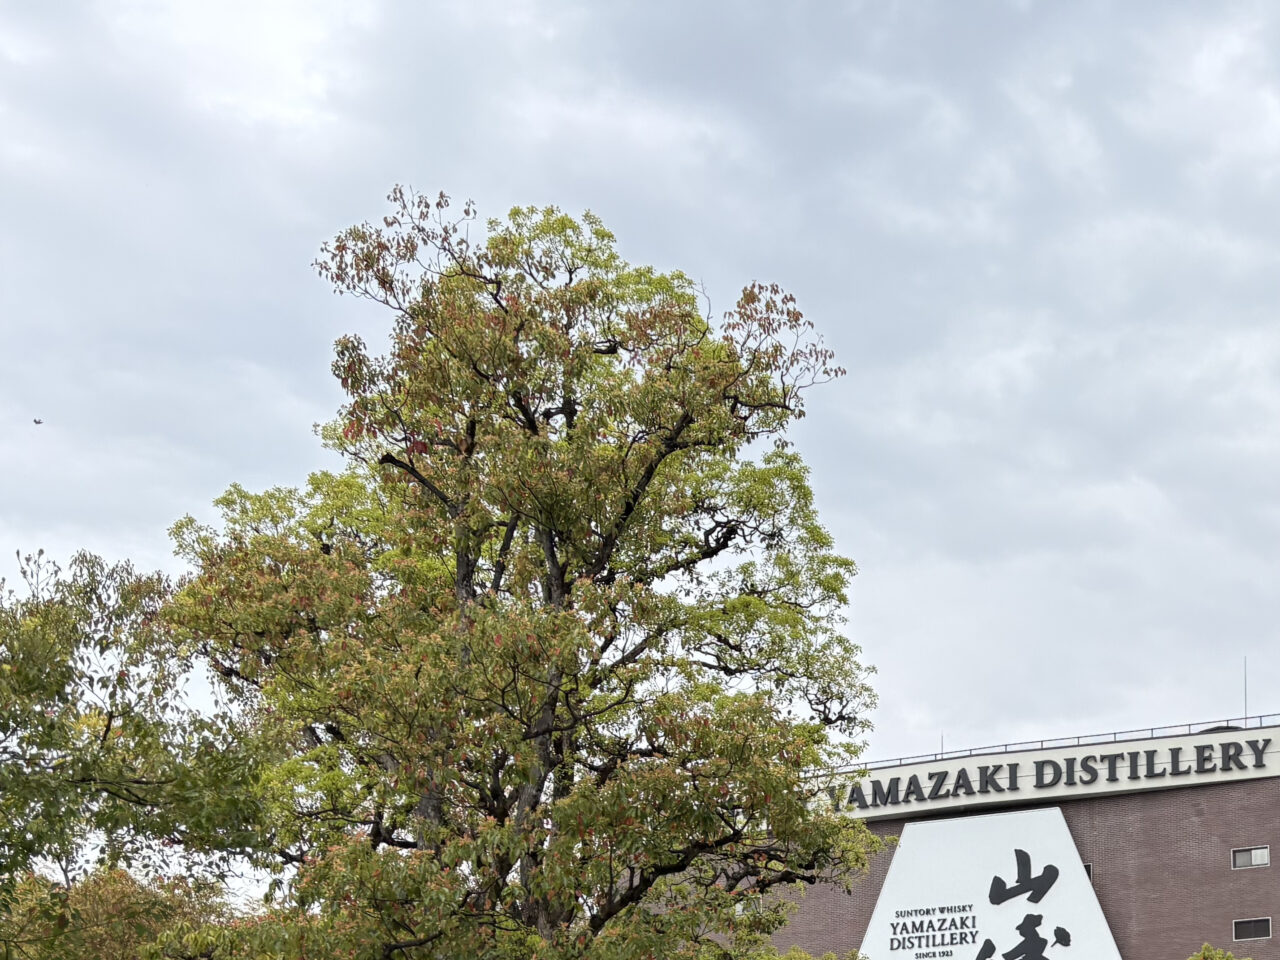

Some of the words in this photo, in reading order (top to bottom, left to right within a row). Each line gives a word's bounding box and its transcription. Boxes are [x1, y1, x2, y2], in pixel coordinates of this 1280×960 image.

[1033, 738, 1272, 788] DISTILLERY
[895, 907, 936, 918] SUNTORY
[938, 904, 973, 914] WHISKY
[890, 915, 977, 936] YAMAZAKI
[889, 930, 979, 951] DISTILLERY
[915, 951, 937, 959] SINCE
[938, 950, 953, 958] 1923
